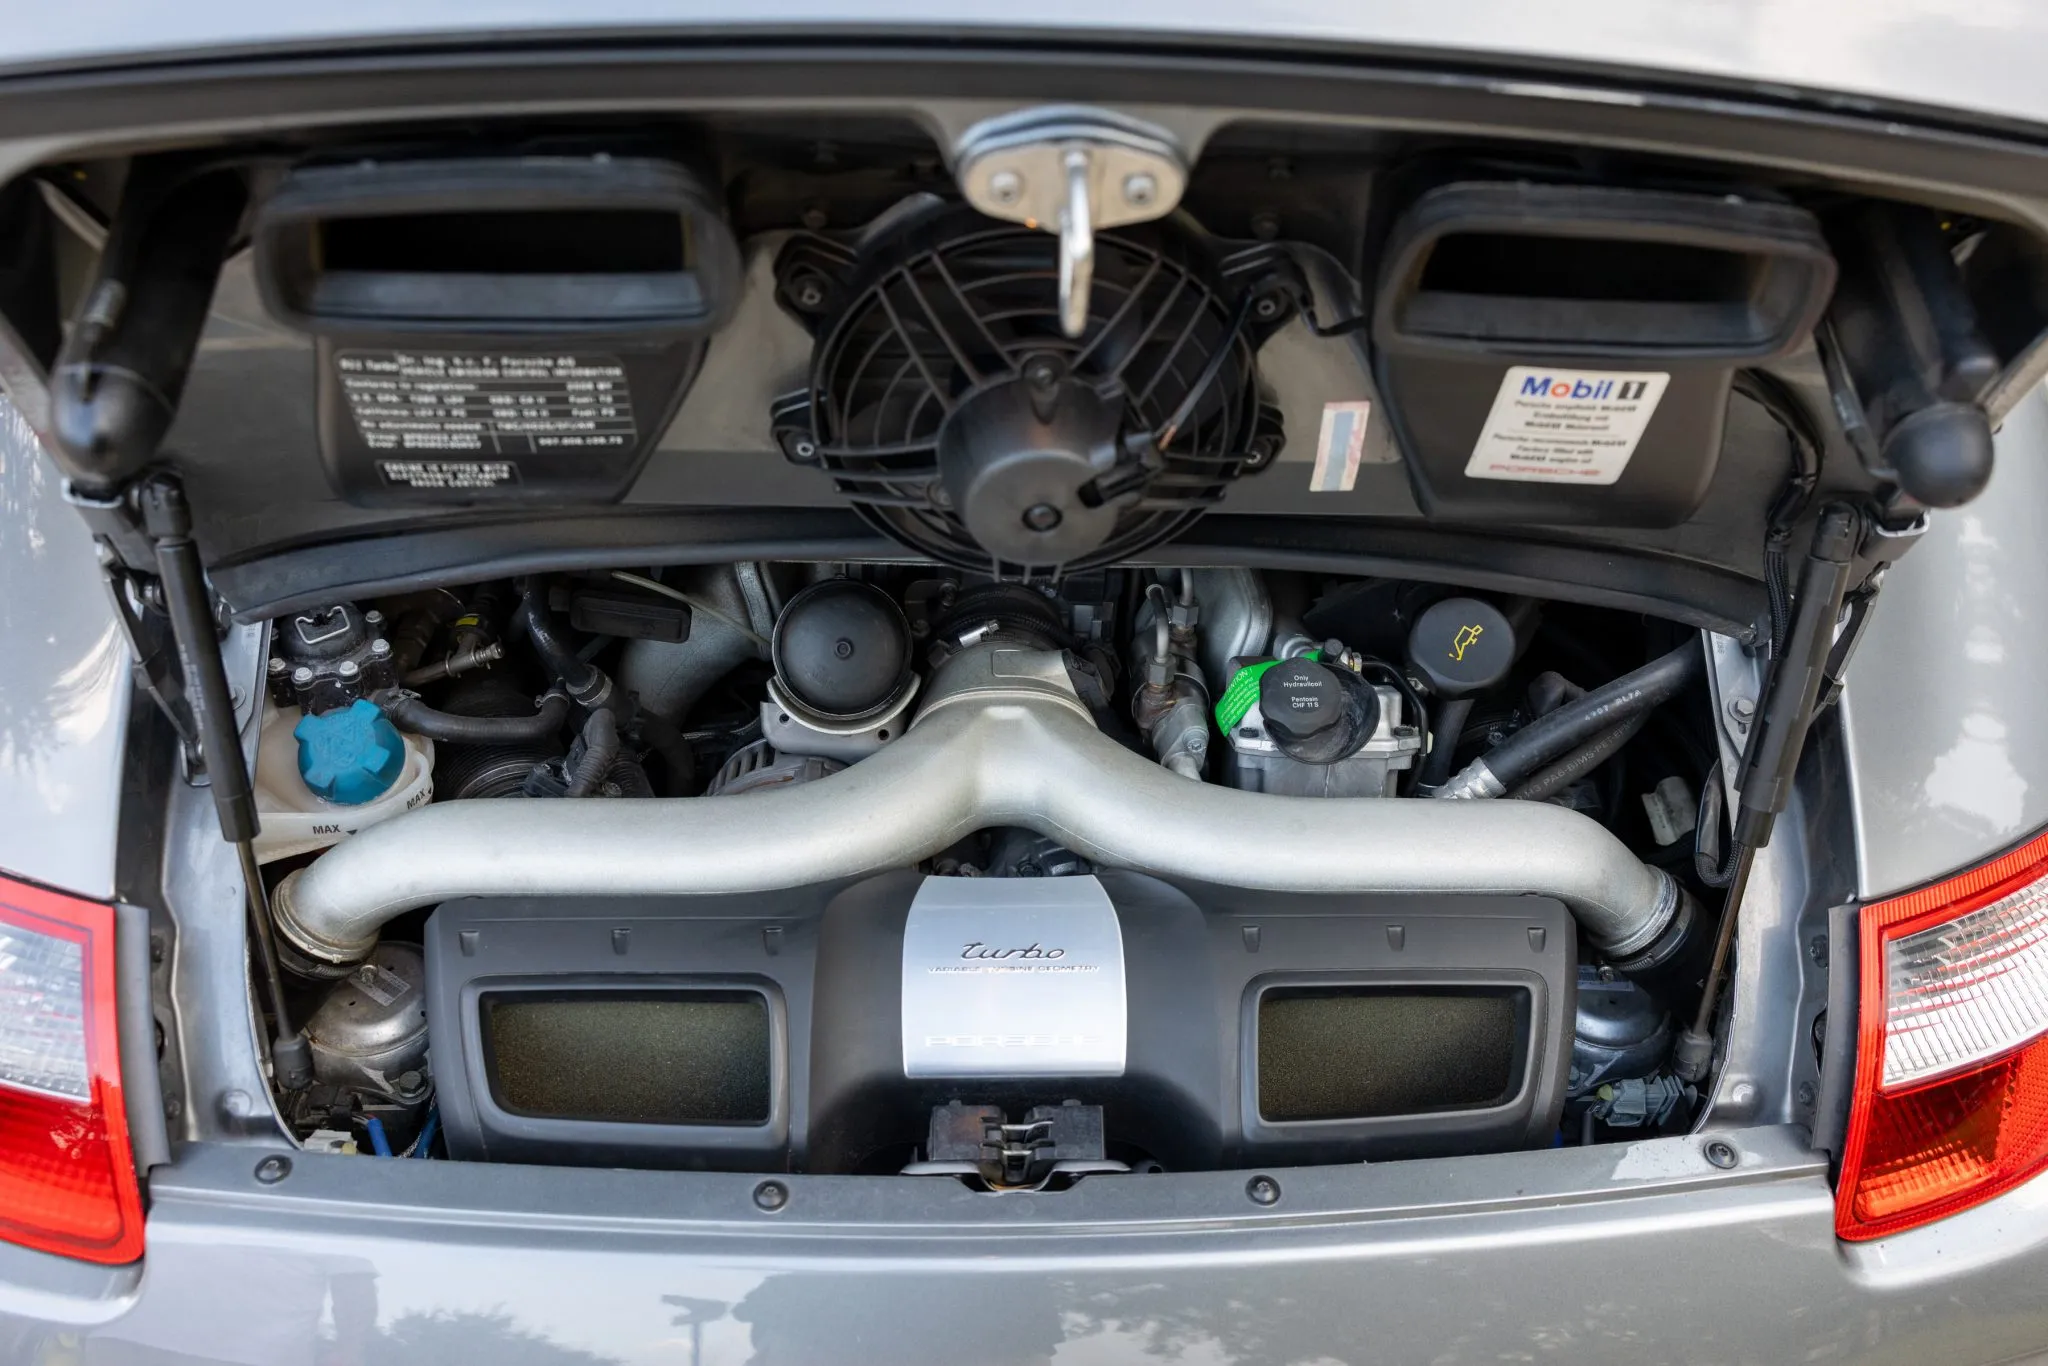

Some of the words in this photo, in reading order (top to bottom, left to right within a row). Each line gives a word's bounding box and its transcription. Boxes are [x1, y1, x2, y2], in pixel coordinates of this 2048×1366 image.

[1520, 376, 1614, 399] Mobil
[406, 788, 426, 809] MAX
[312, 824, 341, 834] MAX
[961, 942, 1065, 959] turbo
[928, 966, 982, 974] VARIABLE
[1038, 965, 1100, 974] GEOMETRY
